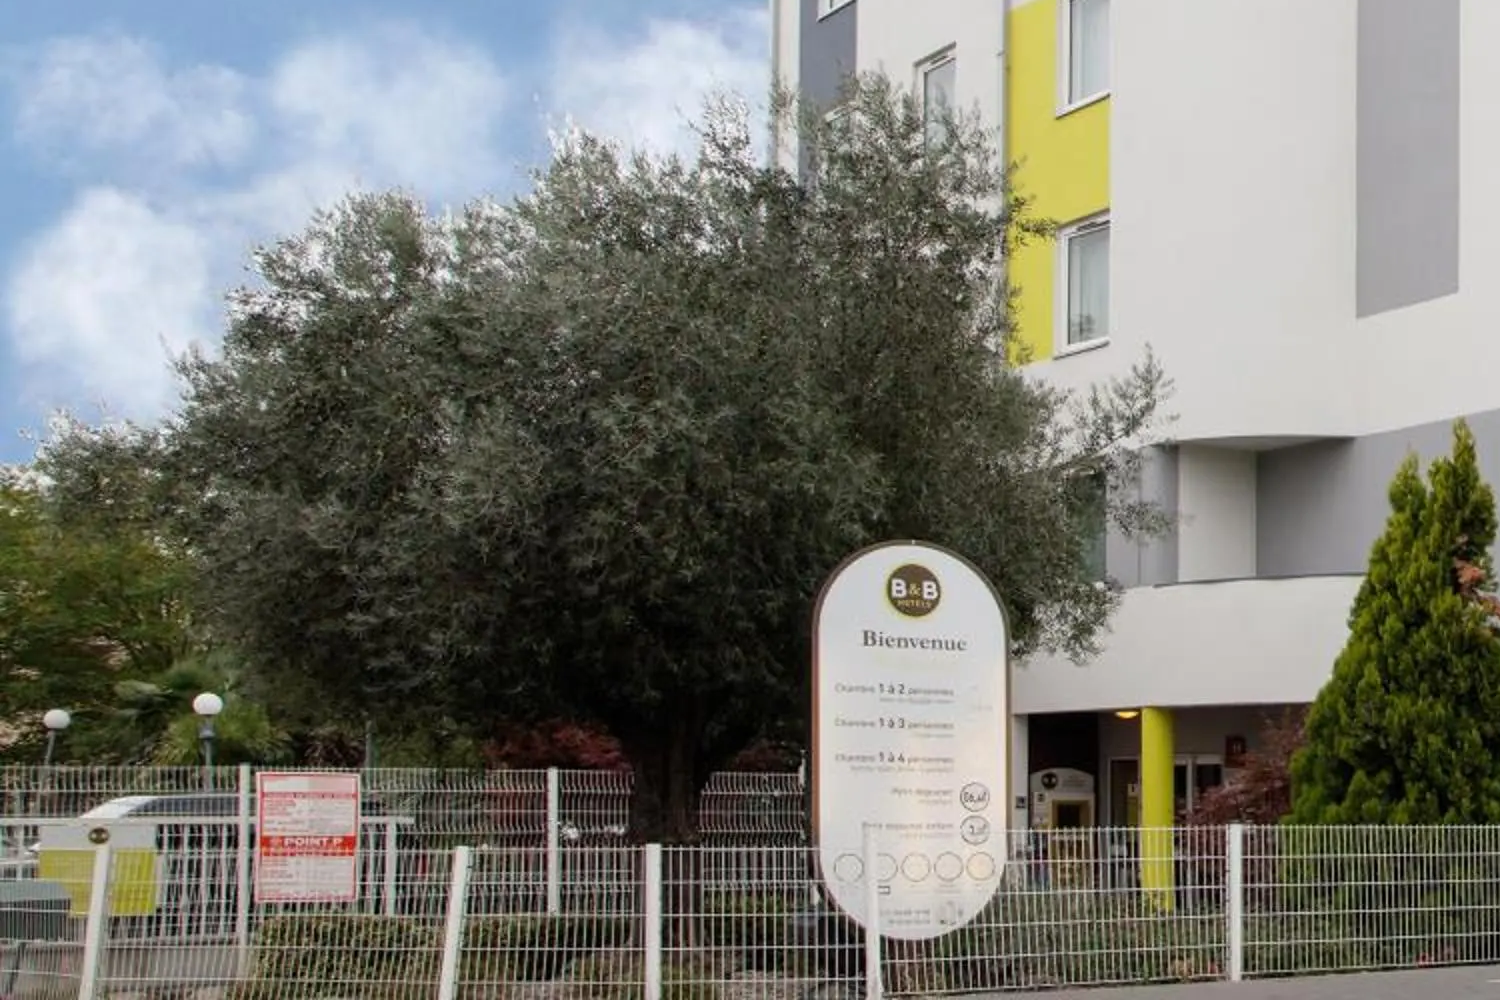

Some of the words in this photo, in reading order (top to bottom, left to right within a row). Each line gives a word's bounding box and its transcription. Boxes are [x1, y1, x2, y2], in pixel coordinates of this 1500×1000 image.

[890, 578, 939, 600] B&B
[862, 630, 968, 652] Bienvenue
[897, 683, 906, 695] 2
[897, 717, 906, 730] 3
[897, 752, 906, 764] 4
